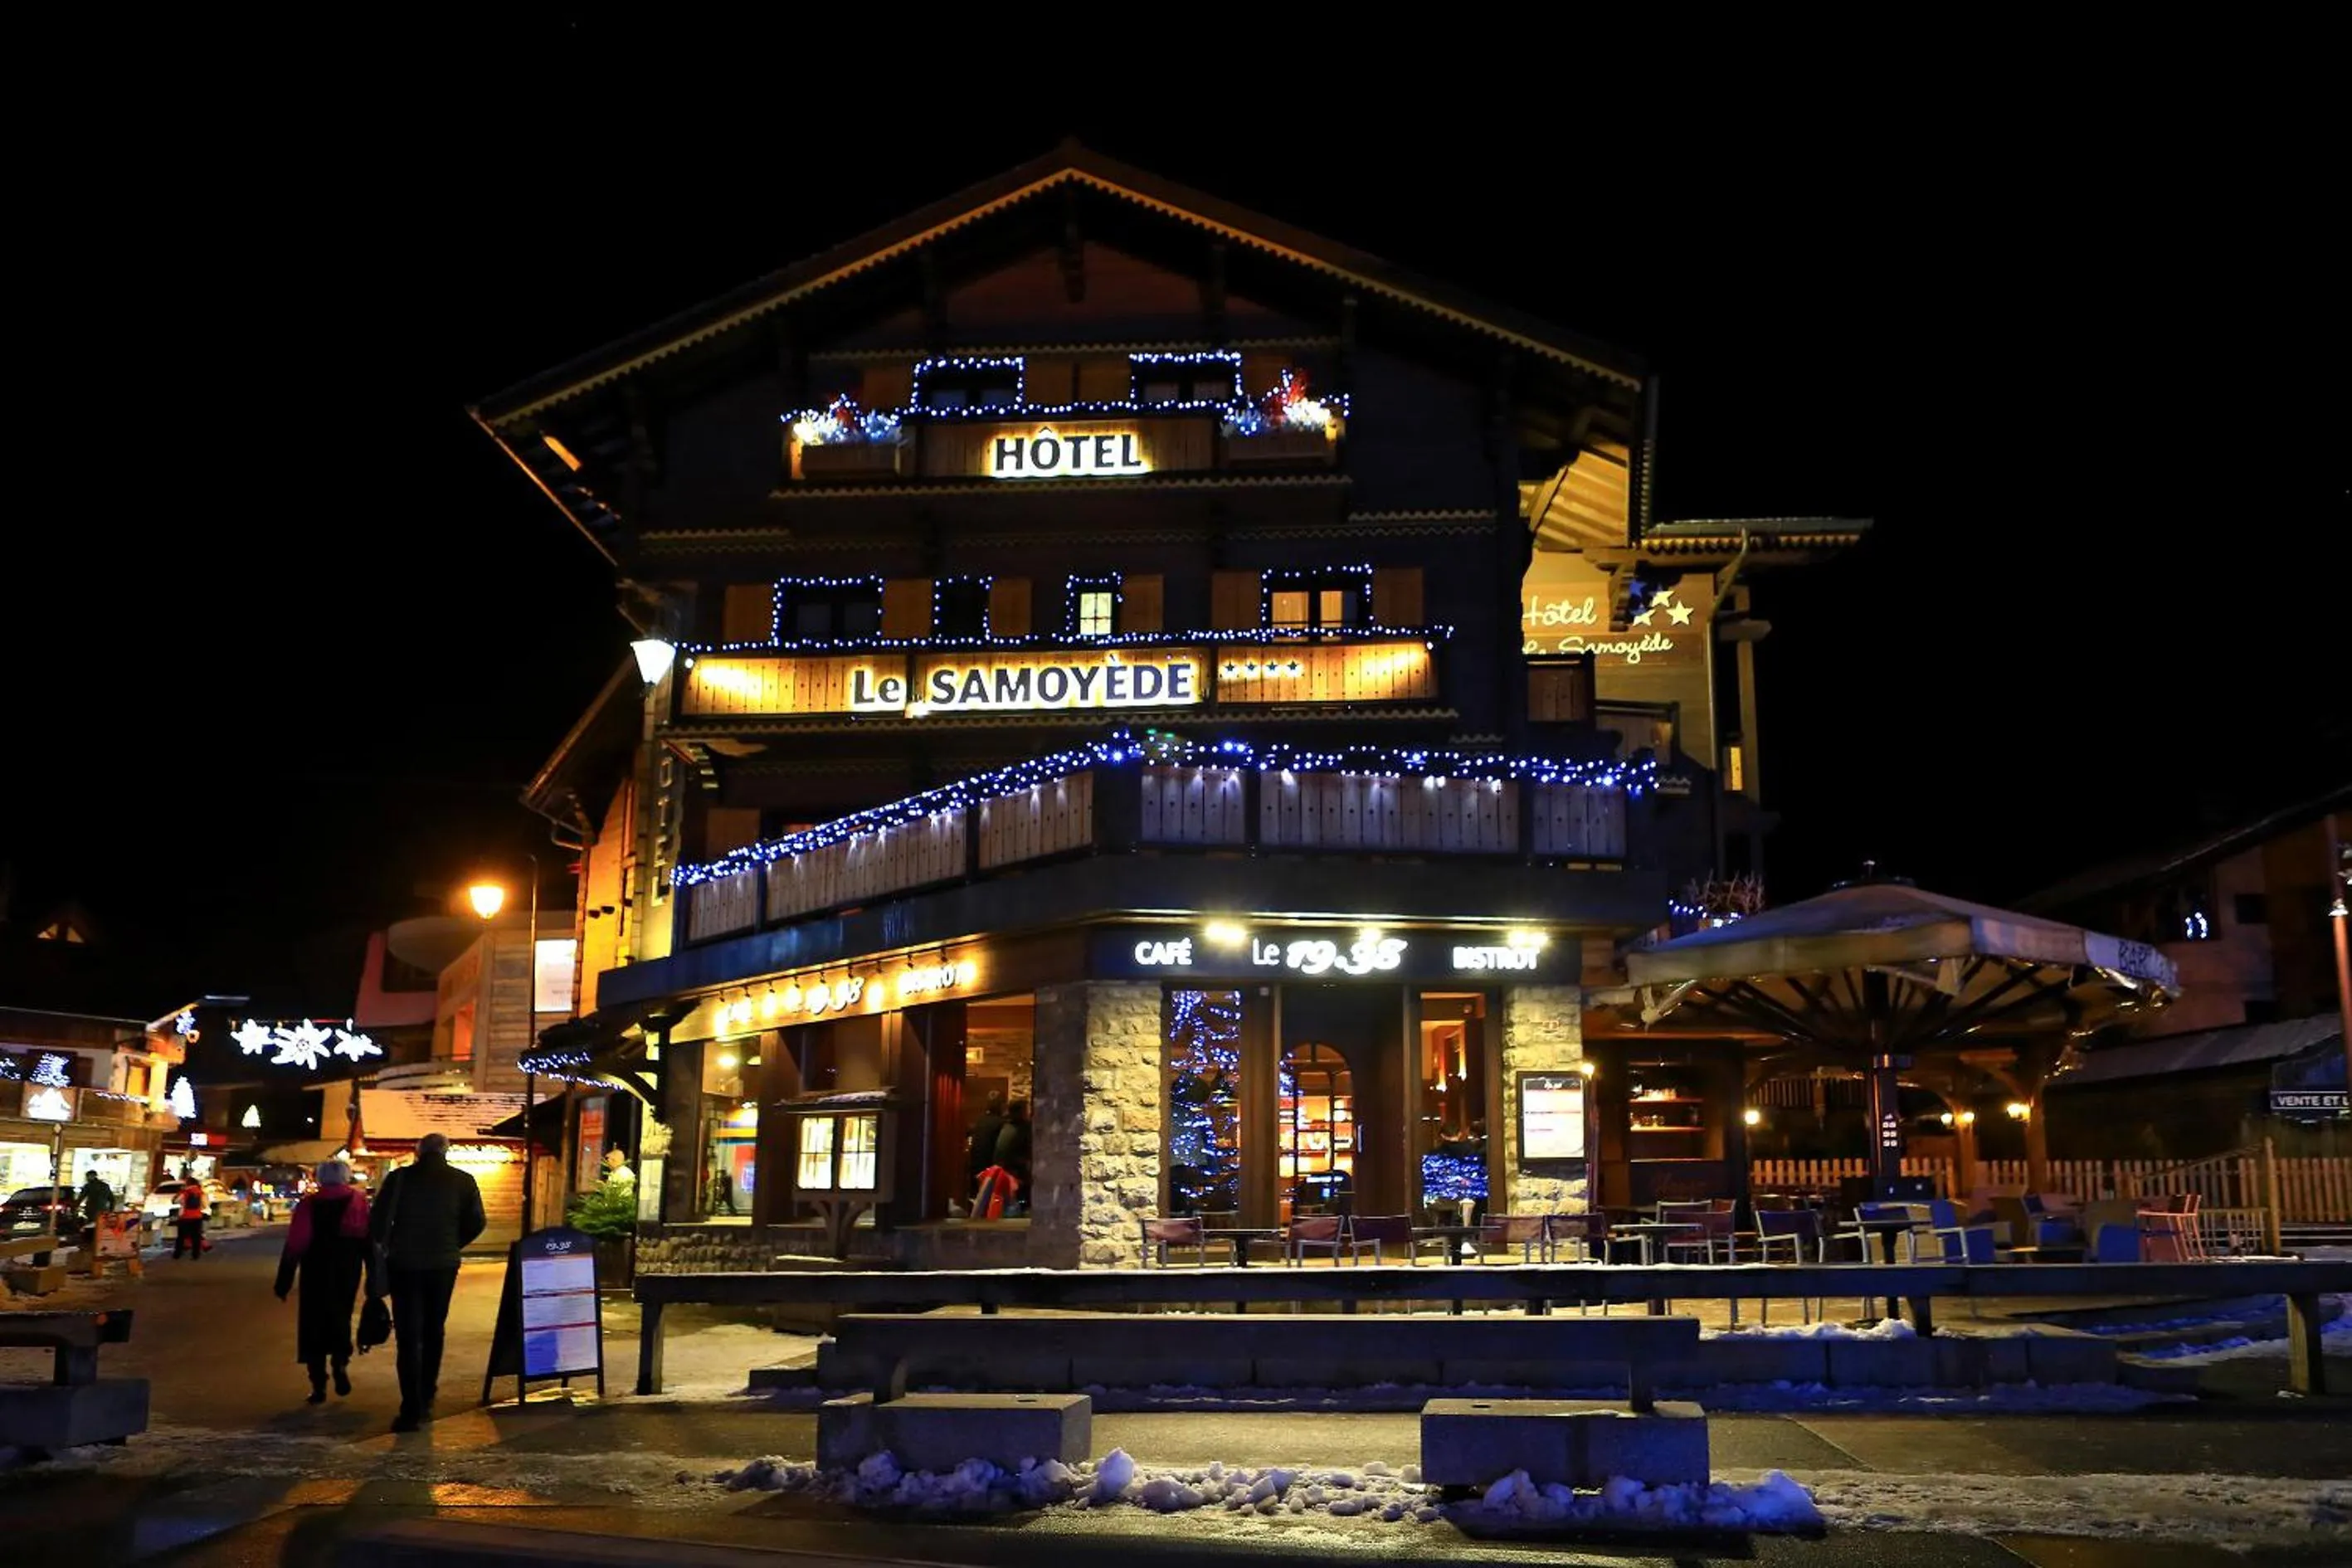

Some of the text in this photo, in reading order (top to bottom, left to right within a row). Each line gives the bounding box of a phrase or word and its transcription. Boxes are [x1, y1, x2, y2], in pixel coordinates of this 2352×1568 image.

[995, 426, 1142, 471] HÔTEL
[854, 653, 1191, 704] Le SAMOYÈDE
[1134, 937, 1192, 965] CAFÉ
[1252, 937, 1280, 966] Le
[2277, 1095, 2321, 1107] VENTE
[2323, 1095, 2340, 1107] ET
